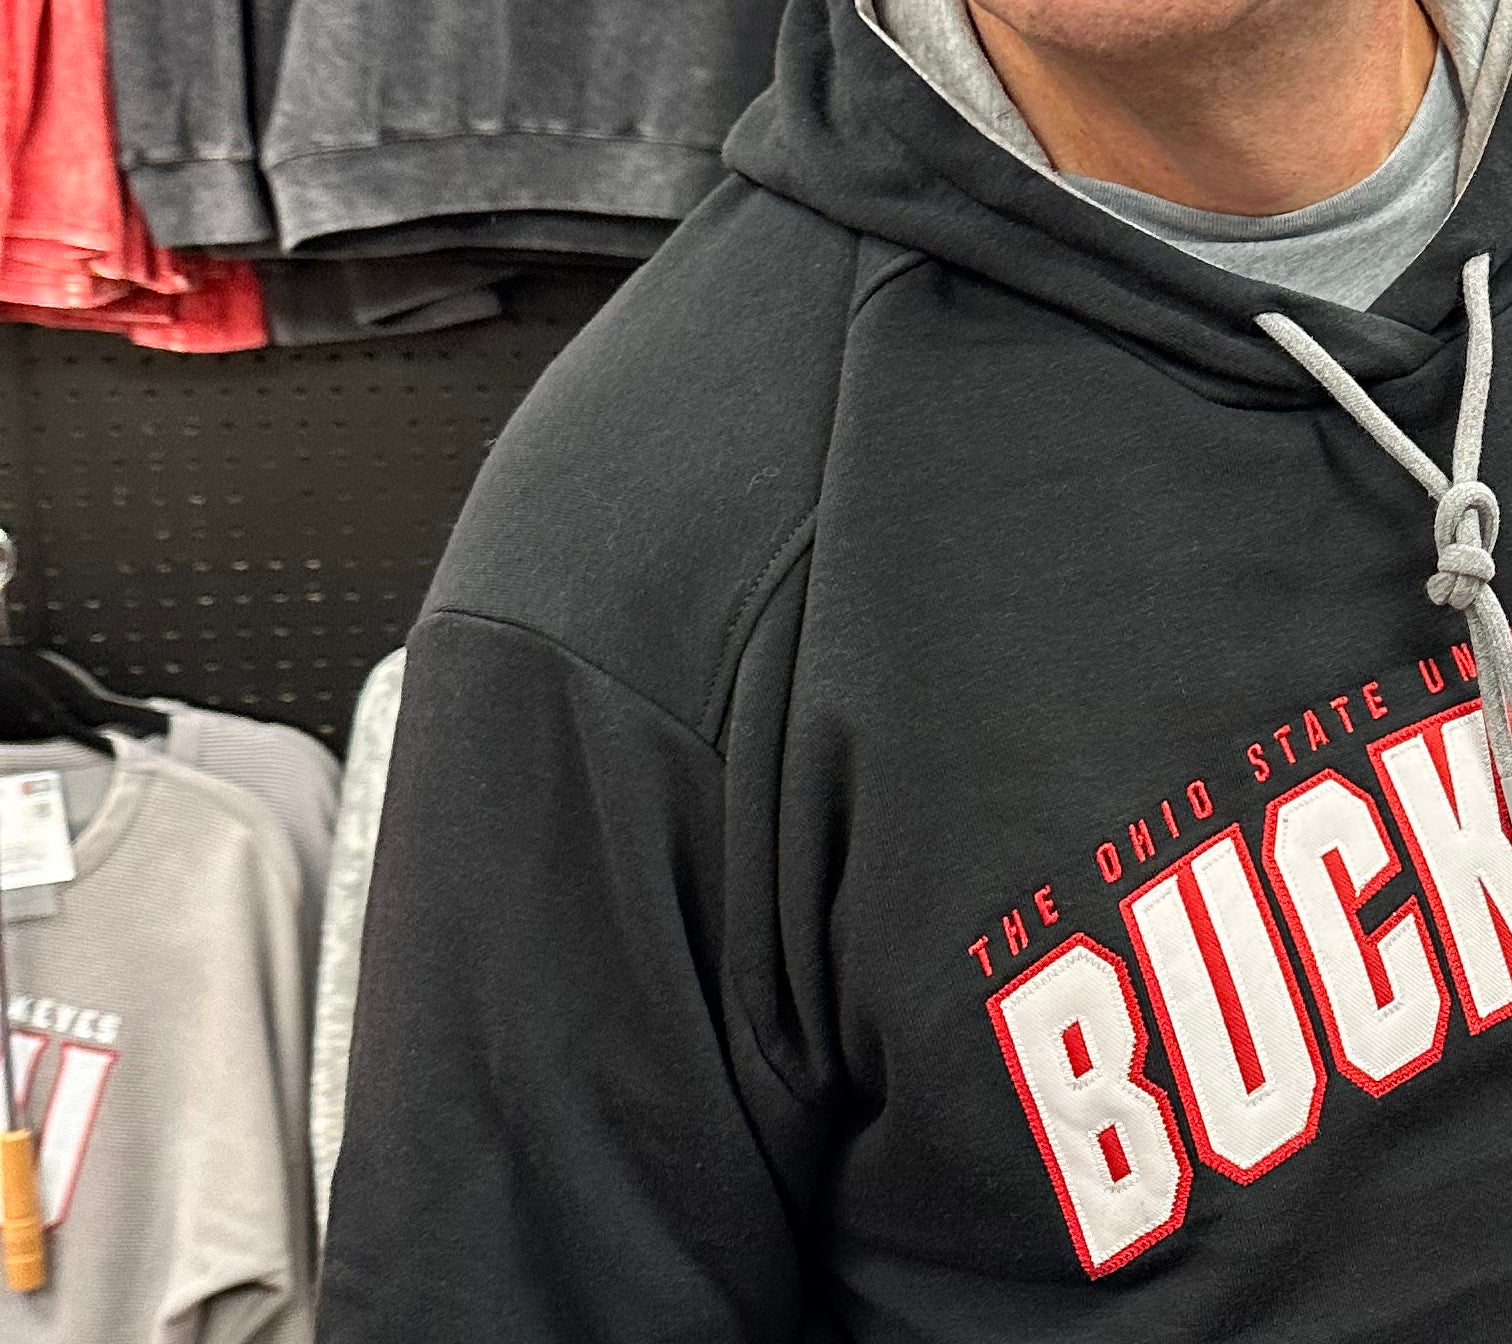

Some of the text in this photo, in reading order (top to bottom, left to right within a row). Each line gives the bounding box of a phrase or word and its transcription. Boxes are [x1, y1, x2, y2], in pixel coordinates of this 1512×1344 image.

[968, 884, 1060, 977] THE
[1096, 779, 1214, 884] OHIO
[1246, 680, 1389, 783] STATE
